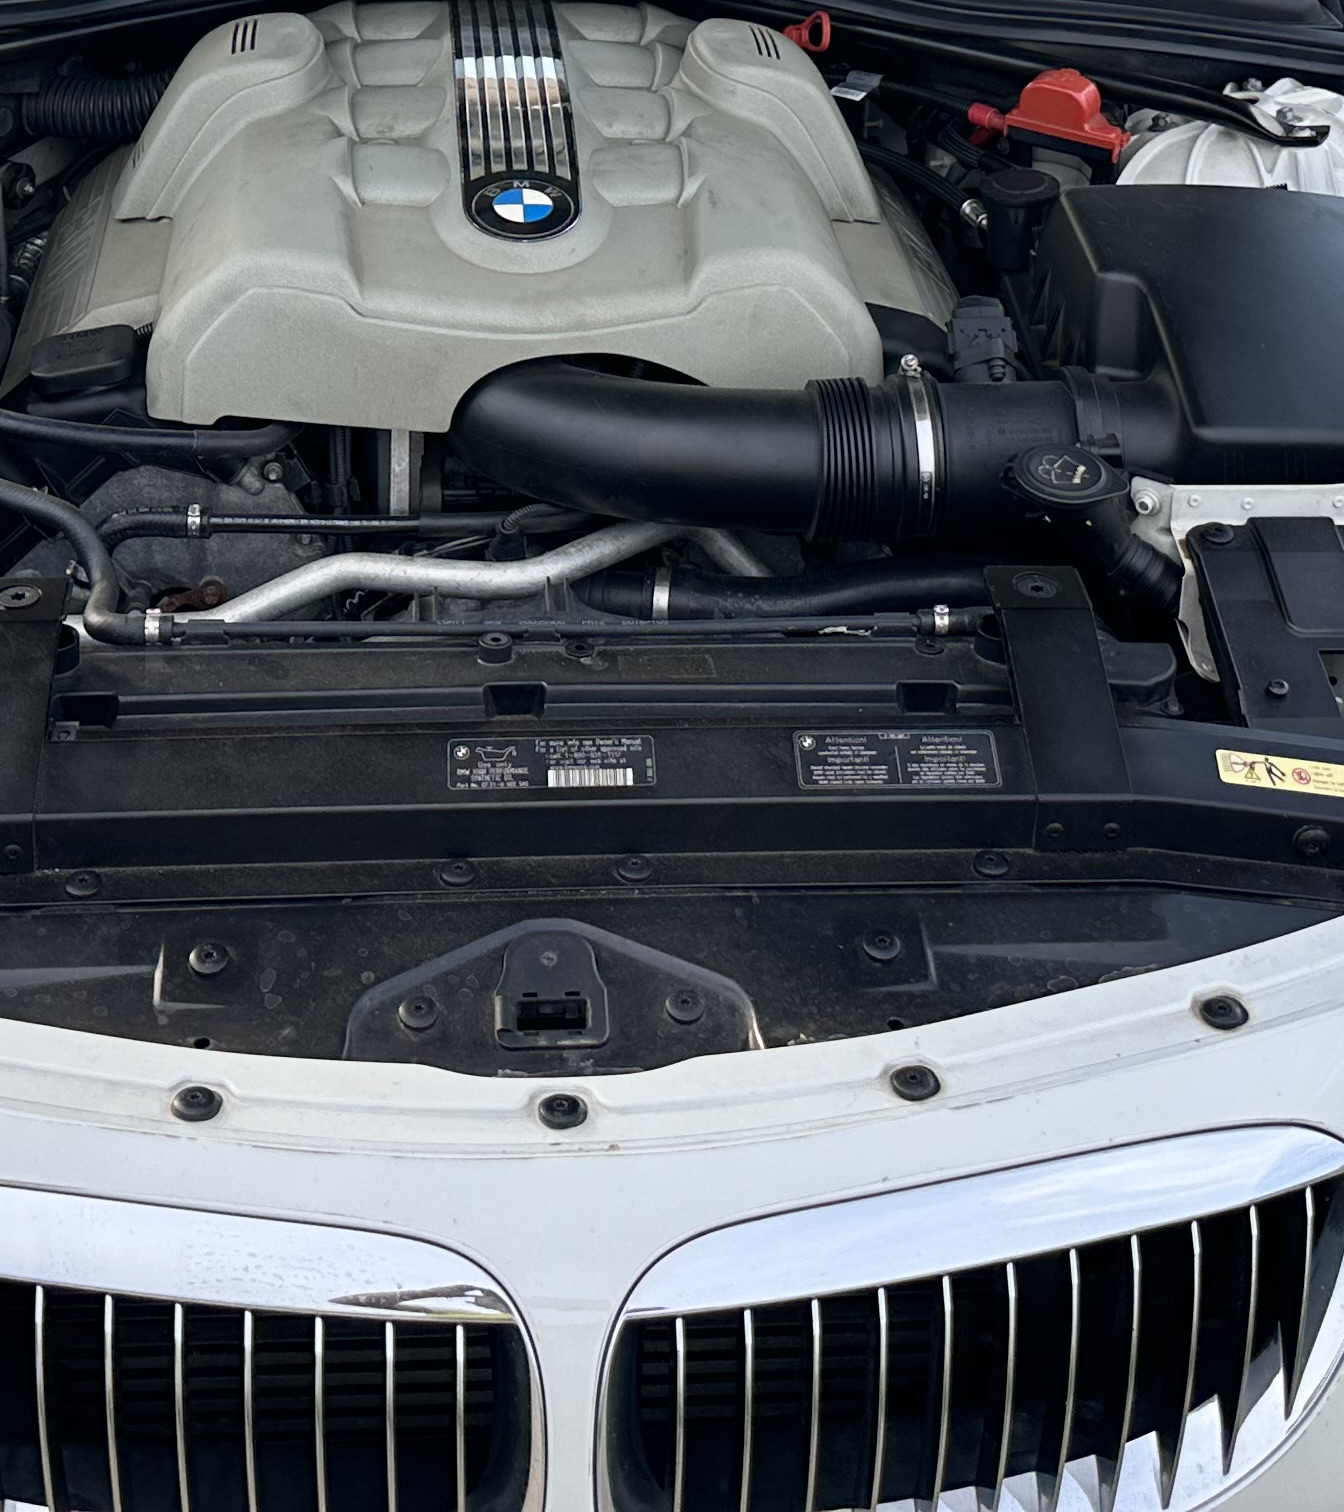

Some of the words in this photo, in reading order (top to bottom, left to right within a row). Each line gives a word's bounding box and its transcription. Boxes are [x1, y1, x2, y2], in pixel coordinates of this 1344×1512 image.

[484, 180, 562, 198] BMW
[535, 738, 547, 746] For
[595, 738, 620, 746] Owner's
[825, 736, 867, 744] Attention!
[921, 735, 963, 743] Attention!
[827, 756, 870, 764] Important!
[923, 755, 966, 763] Important!
[495, 760, 513, 769] only
